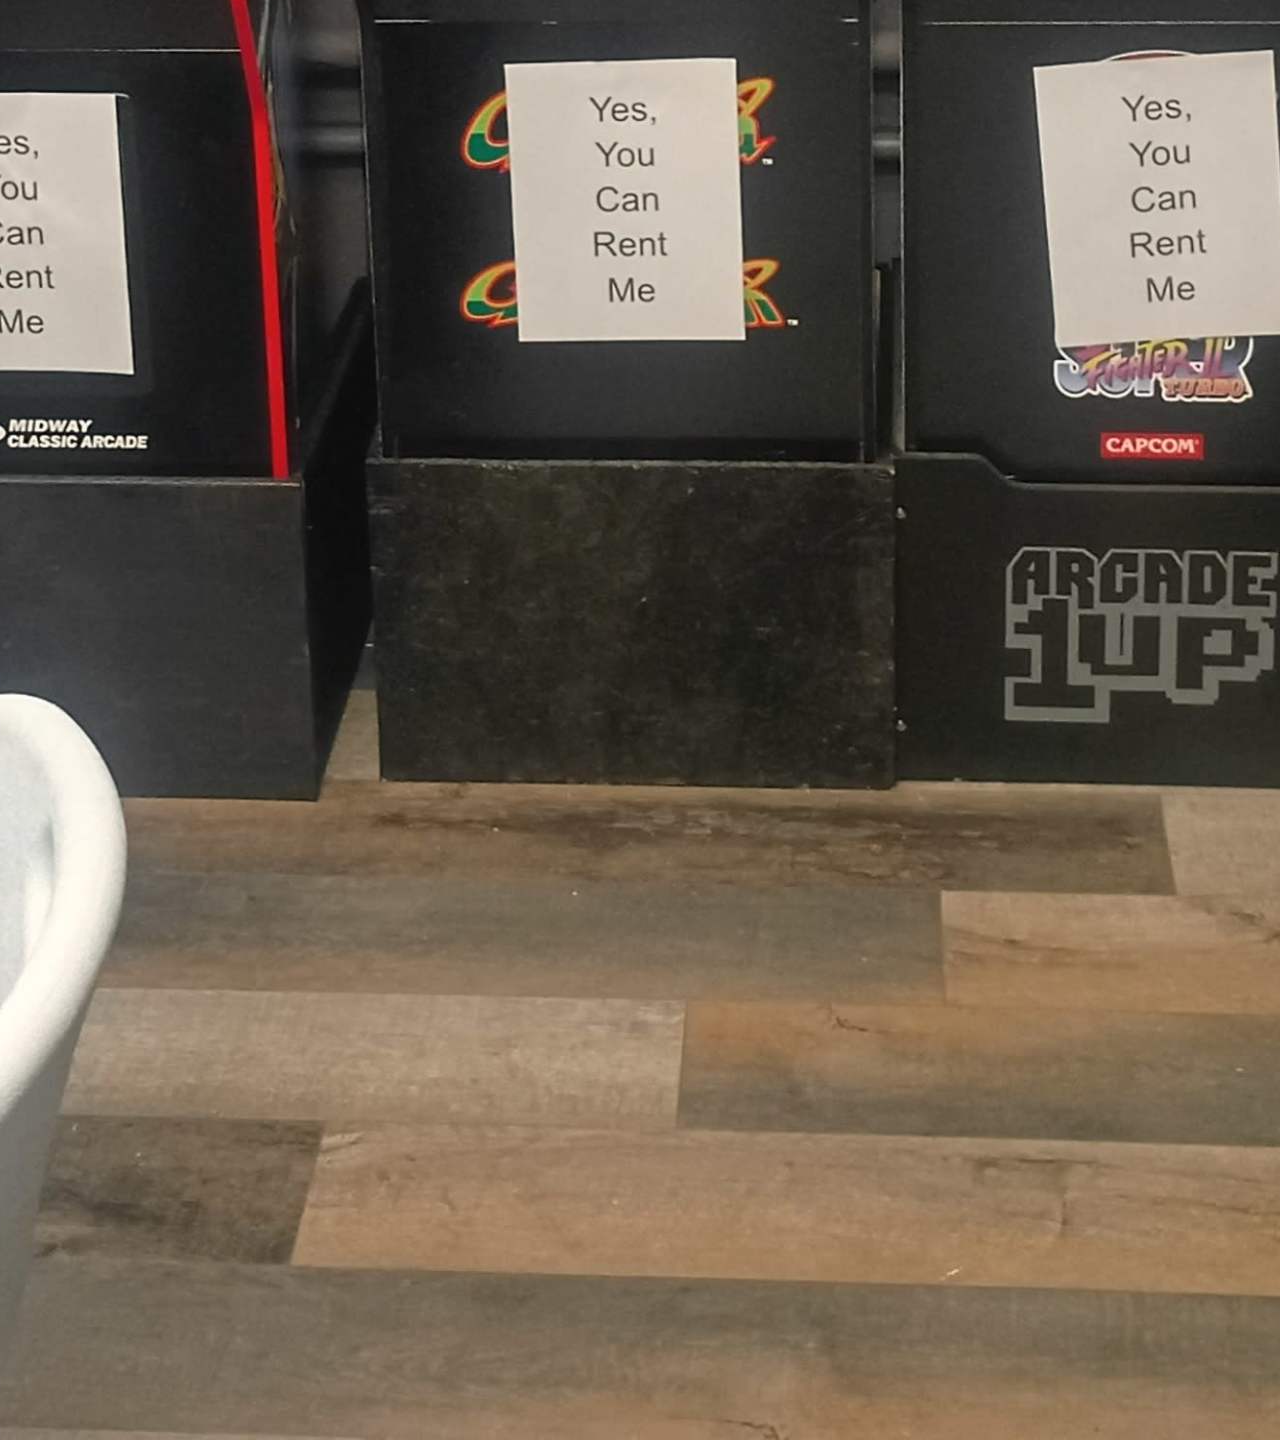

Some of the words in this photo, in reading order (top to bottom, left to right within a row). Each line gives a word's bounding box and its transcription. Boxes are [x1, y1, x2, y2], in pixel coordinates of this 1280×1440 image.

[589, 96, 657, 125] Yes,
[1121, 95, 1192, 123] Yes,
[595, 141, 655, 168] You
[1129, 140, 1191, 167] You
[596, 186, 660, 213] Can
[1131, 186, 1197, 214] Can
[593, 231, 667, 258] Rent
[1130, 228, 1207, 259] Rent
[608, 277, 656, 303] Me
[1146, 276, 1196, 303] Me
[8, 419, 93, 433] MIDWAY
[7, 434, 81, 449] CLASSIC
[82, 434, 149, 450] ARCADE
[1106, 438, 1199, 455] CAPCOM
[1006, 548, 1276, 612] ARCADE
